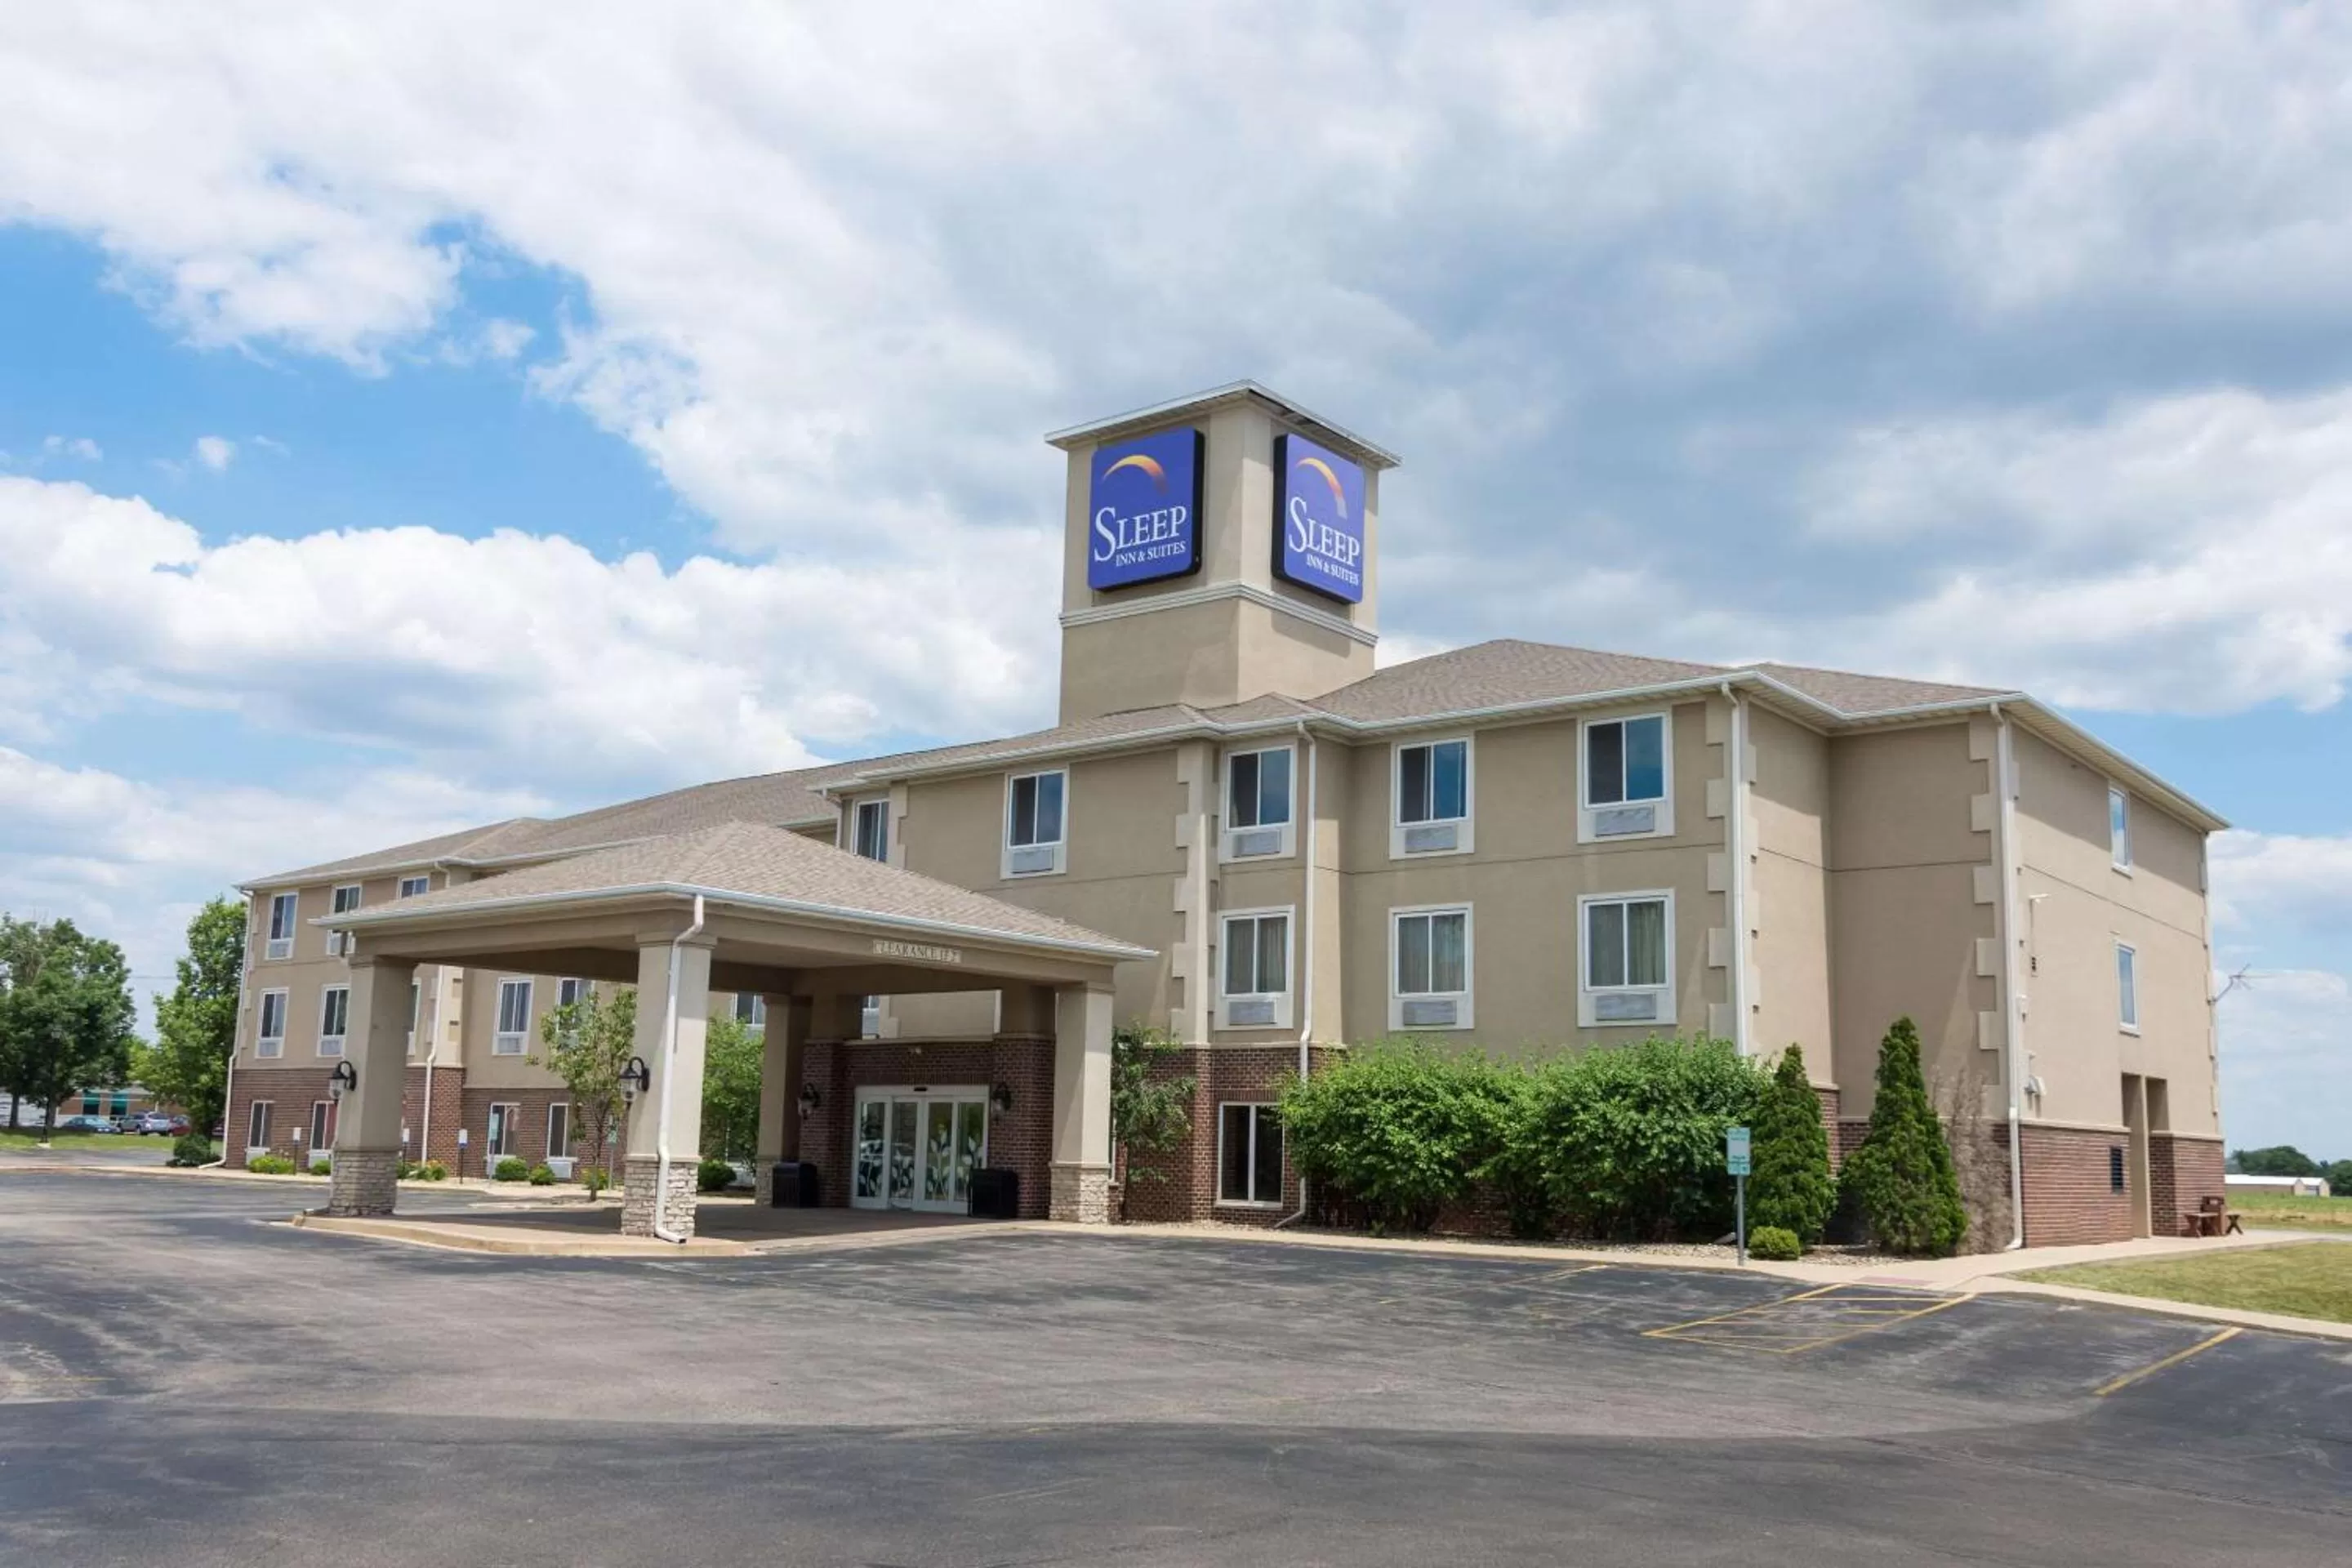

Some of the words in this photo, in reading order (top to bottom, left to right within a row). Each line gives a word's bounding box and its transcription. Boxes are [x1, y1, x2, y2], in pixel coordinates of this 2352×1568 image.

[1094, 506, 1187, 562] SLEEP
[1116, 552, 1136, 567] INN
[1138, 551, 1145, 563] &
[1147, 541, 1187, 560] SUITES
[1289, 497, 1360, 567] SLEEP
[1307, 553, 1322, 572] INN
[1323, 562, 1330, 573] &
[1331, 564, 1359, 586] SUITES
